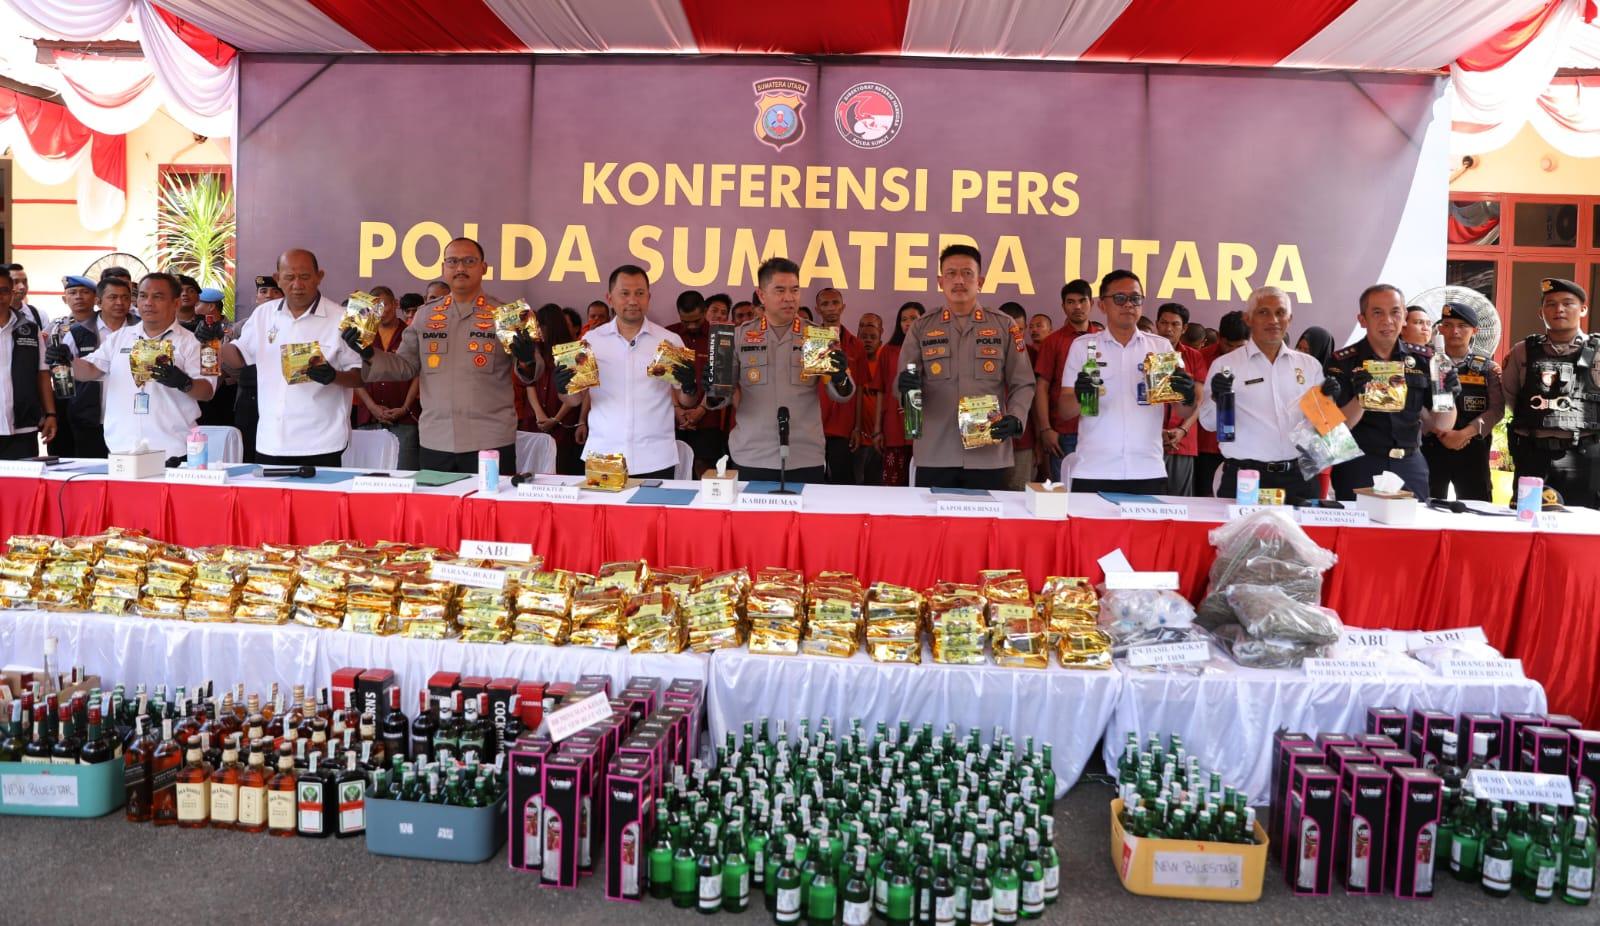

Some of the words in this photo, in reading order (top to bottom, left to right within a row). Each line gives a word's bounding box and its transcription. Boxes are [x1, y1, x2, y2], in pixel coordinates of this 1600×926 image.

[757, 81, 787, 91] SUMATERA
[787, 82, 806, 92] UTARA
[582, 162, 927, 212] KONFERENSI
[951, 169, 1080, 217] PERS
[1065, 237, 1313, 304] UTARA
[469, 331, 496, 340] POLRI
[742, 497, 768, 505] KABID
[475, 544, 513, 557] SABU
[1349, 634, 1389, 647] SABU
[1423, 631, 1466, 645] SABU
[4, 783, 25, 796] NEW
[1155, 860, 1178, 873] NEW
[1184, 860, 1240, 875] BLUESTAR
